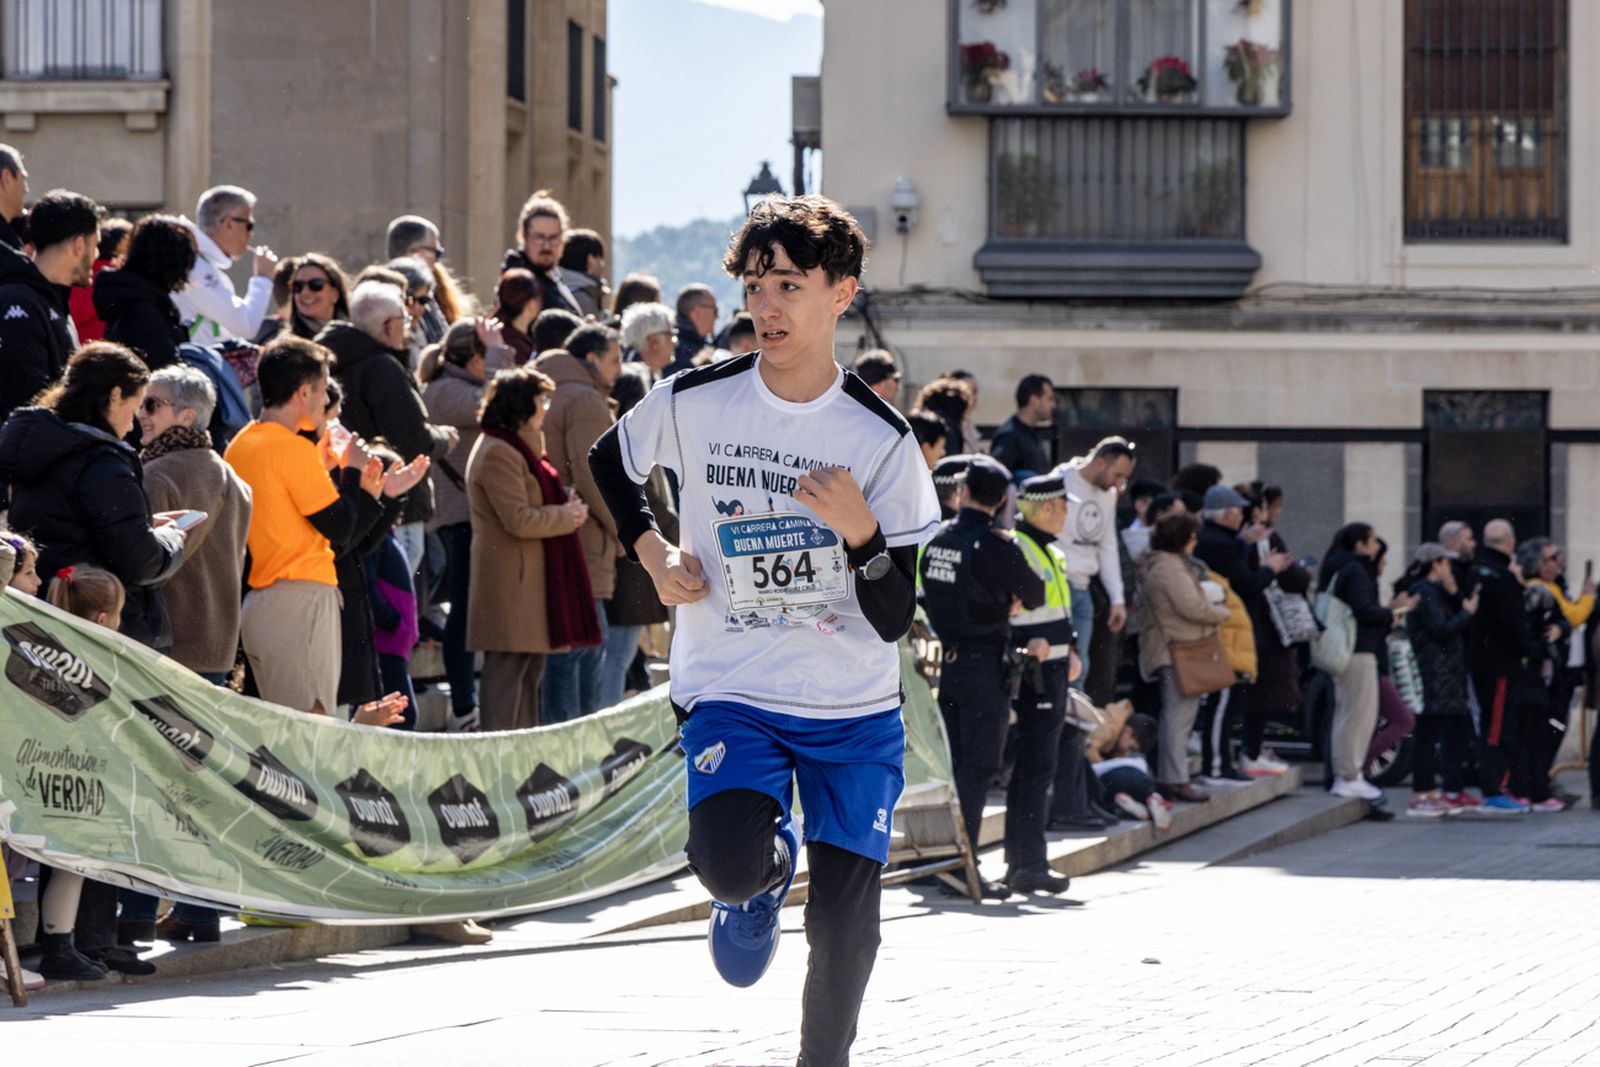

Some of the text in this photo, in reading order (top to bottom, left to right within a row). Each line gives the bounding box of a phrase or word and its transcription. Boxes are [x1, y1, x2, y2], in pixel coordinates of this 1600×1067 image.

[709, 442, 852, 474] VI CARRERA CAMIN
[706, 464, 757, 488] BUENA
[731, 519, 815, 535] VI CARRERA CAMINA
[733, 532, 807, 552] BUENA MUERTE
[752, 551, 816, 589] 564
[38, 771, 106, 817] VERDAD
[256, 764, 308, 806] ownat
[529, 782, 573, 820] ownat
[350, 796, 399, 827] ownat
[440, 797, 490, 829] ownat
